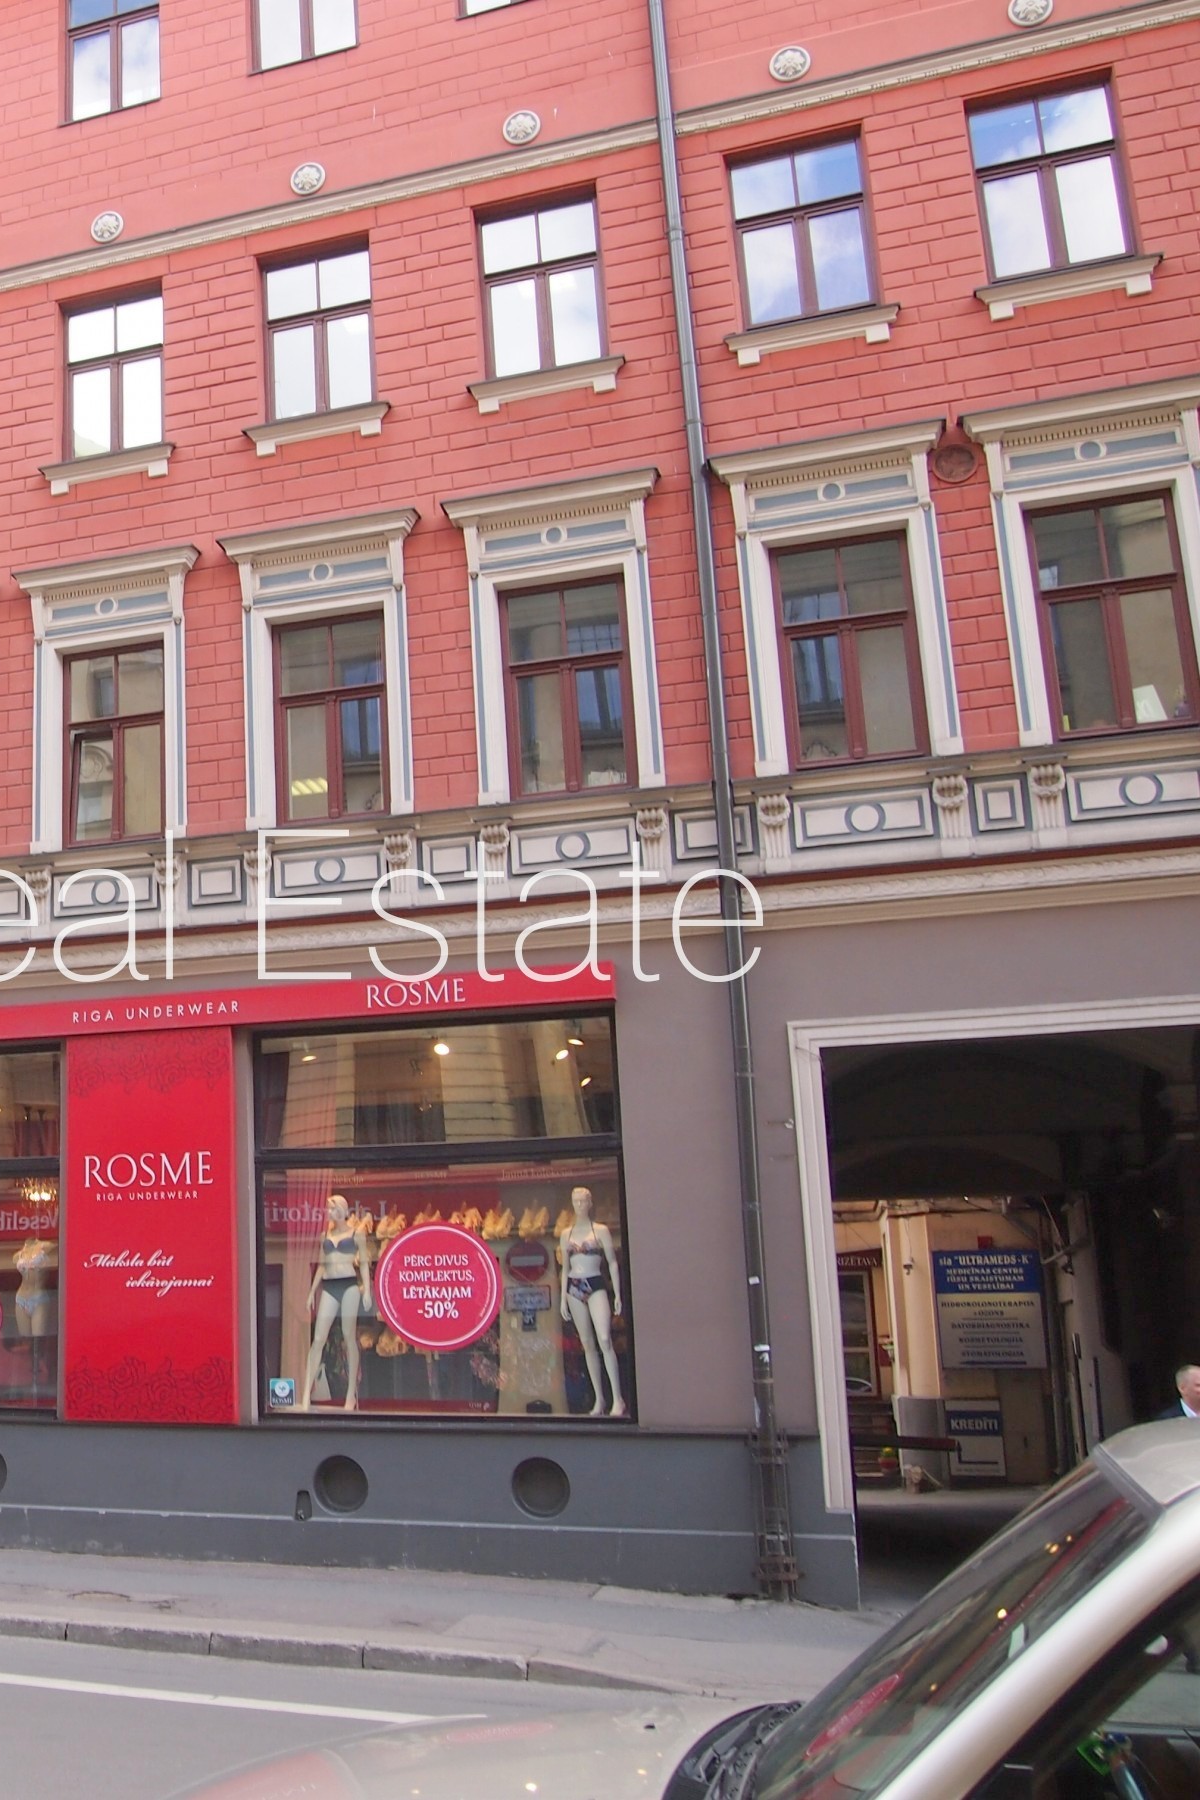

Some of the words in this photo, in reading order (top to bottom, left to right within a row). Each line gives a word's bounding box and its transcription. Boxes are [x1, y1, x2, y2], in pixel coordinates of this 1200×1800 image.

[366, 978, 466, 1008] ROSME
[72, 1010, 114, 1023] RIGA
[126, 1000, 239, 1020] UNDERWEAR
[84, 1151, 213, 1188] ROSME
[96, 1192, 122, 1201] RIGA
[129, 1190, 198, 1200] UNDERWEAR
[404, 1254, 431, 1267] PĒRC
[434, 1254, 469, 1266] DIVUS
[399, 1269, 475, 1283] KOMPLEKTUS,
[403, 1285, 472, 1301] LĒTĀKAJAM
[418, 1301, 459, 1319] -50%
[950, 1416, 998, 1430] KREDĪTI
